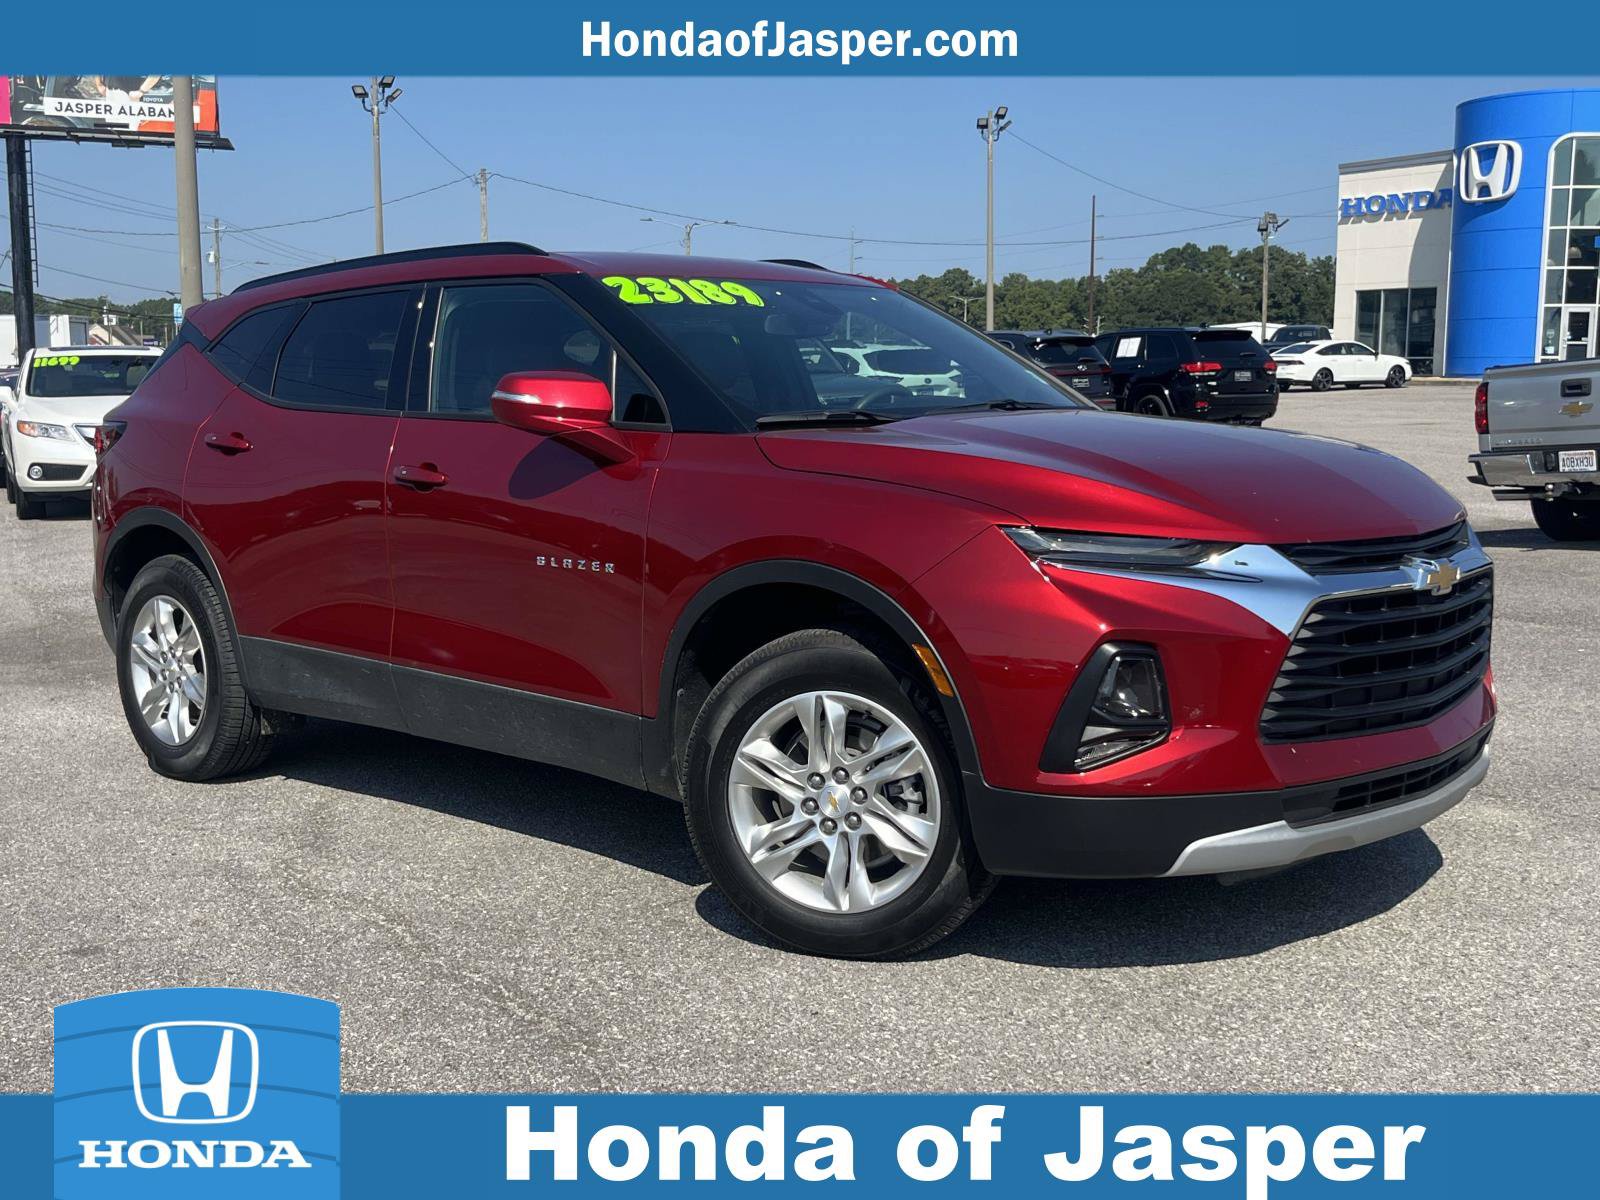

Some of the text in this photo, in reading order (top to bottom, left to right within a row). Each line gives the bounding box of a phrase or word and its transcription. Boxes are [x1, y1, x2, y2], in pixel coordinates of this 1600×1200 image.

[54, 101, 175, 118] JASPER ALABA
[1340, 187, 1453, 218] HONDA
[602, 276, 765, 307] 23189
[536, 556, 615, 574] BLAZER
